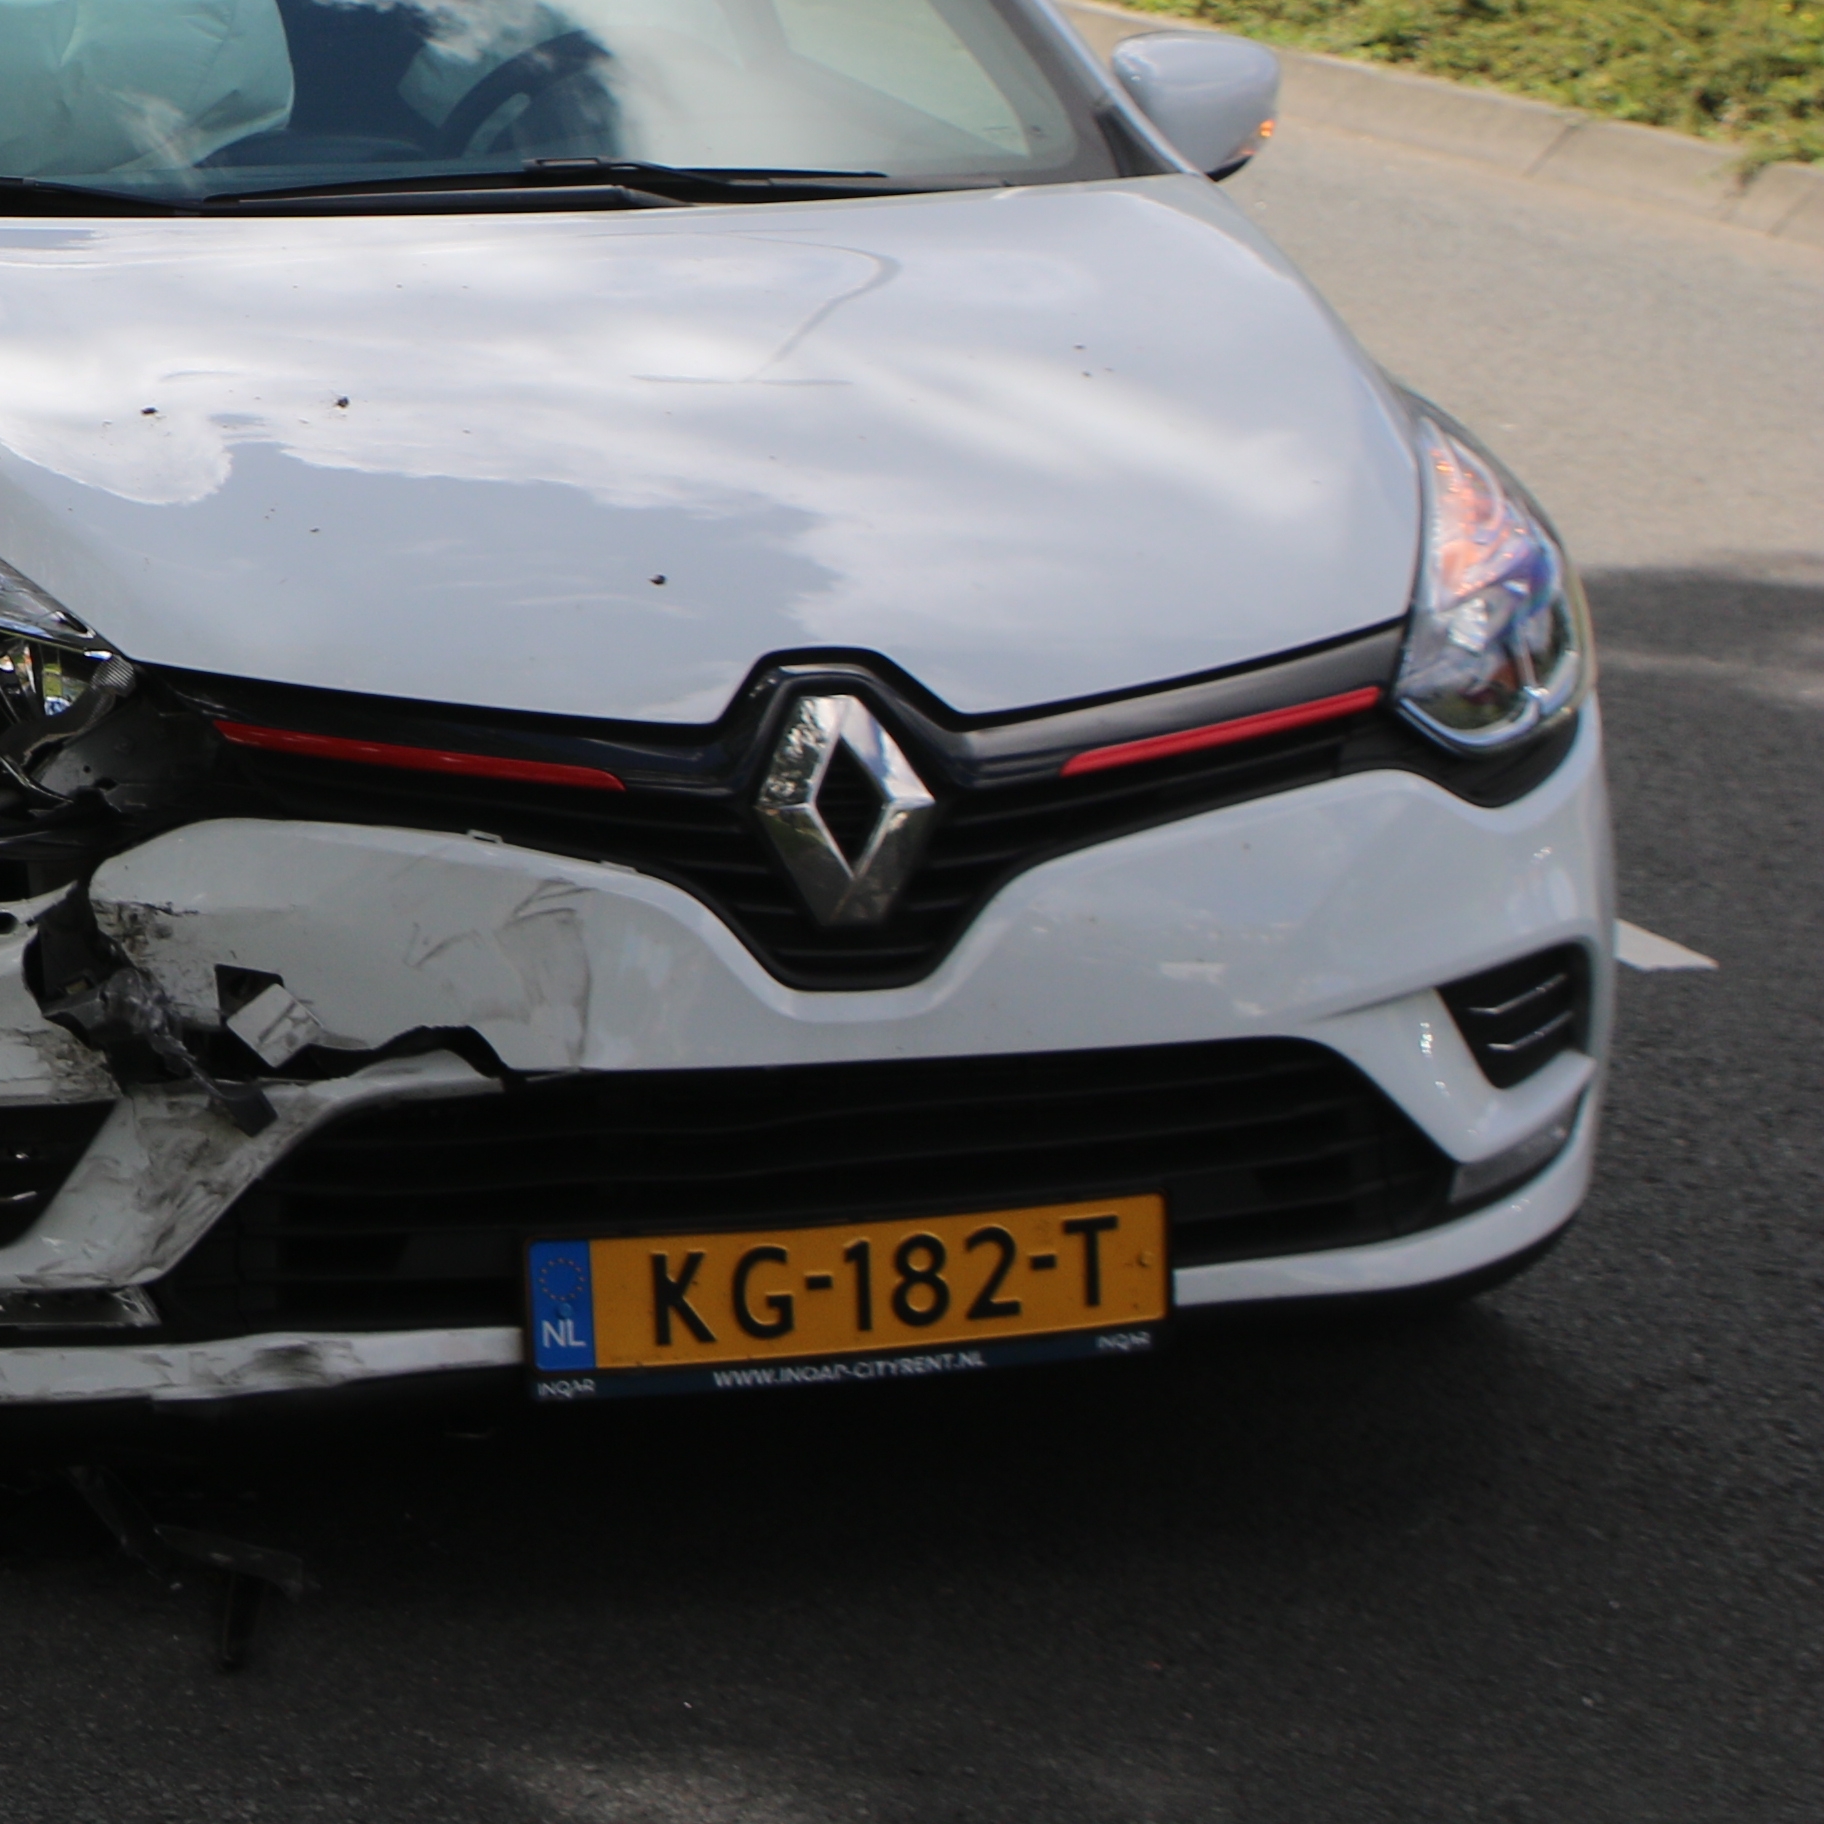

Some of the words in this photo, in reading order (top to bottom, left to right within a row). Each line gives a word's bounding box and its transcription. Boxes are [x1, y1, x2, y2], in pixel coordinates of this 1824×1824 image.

[651, 1214, 1120, 1347] KG-182-T
[542, 1319, 586, 1348] NL
[537, 1378, 596, 1398] INQAR
